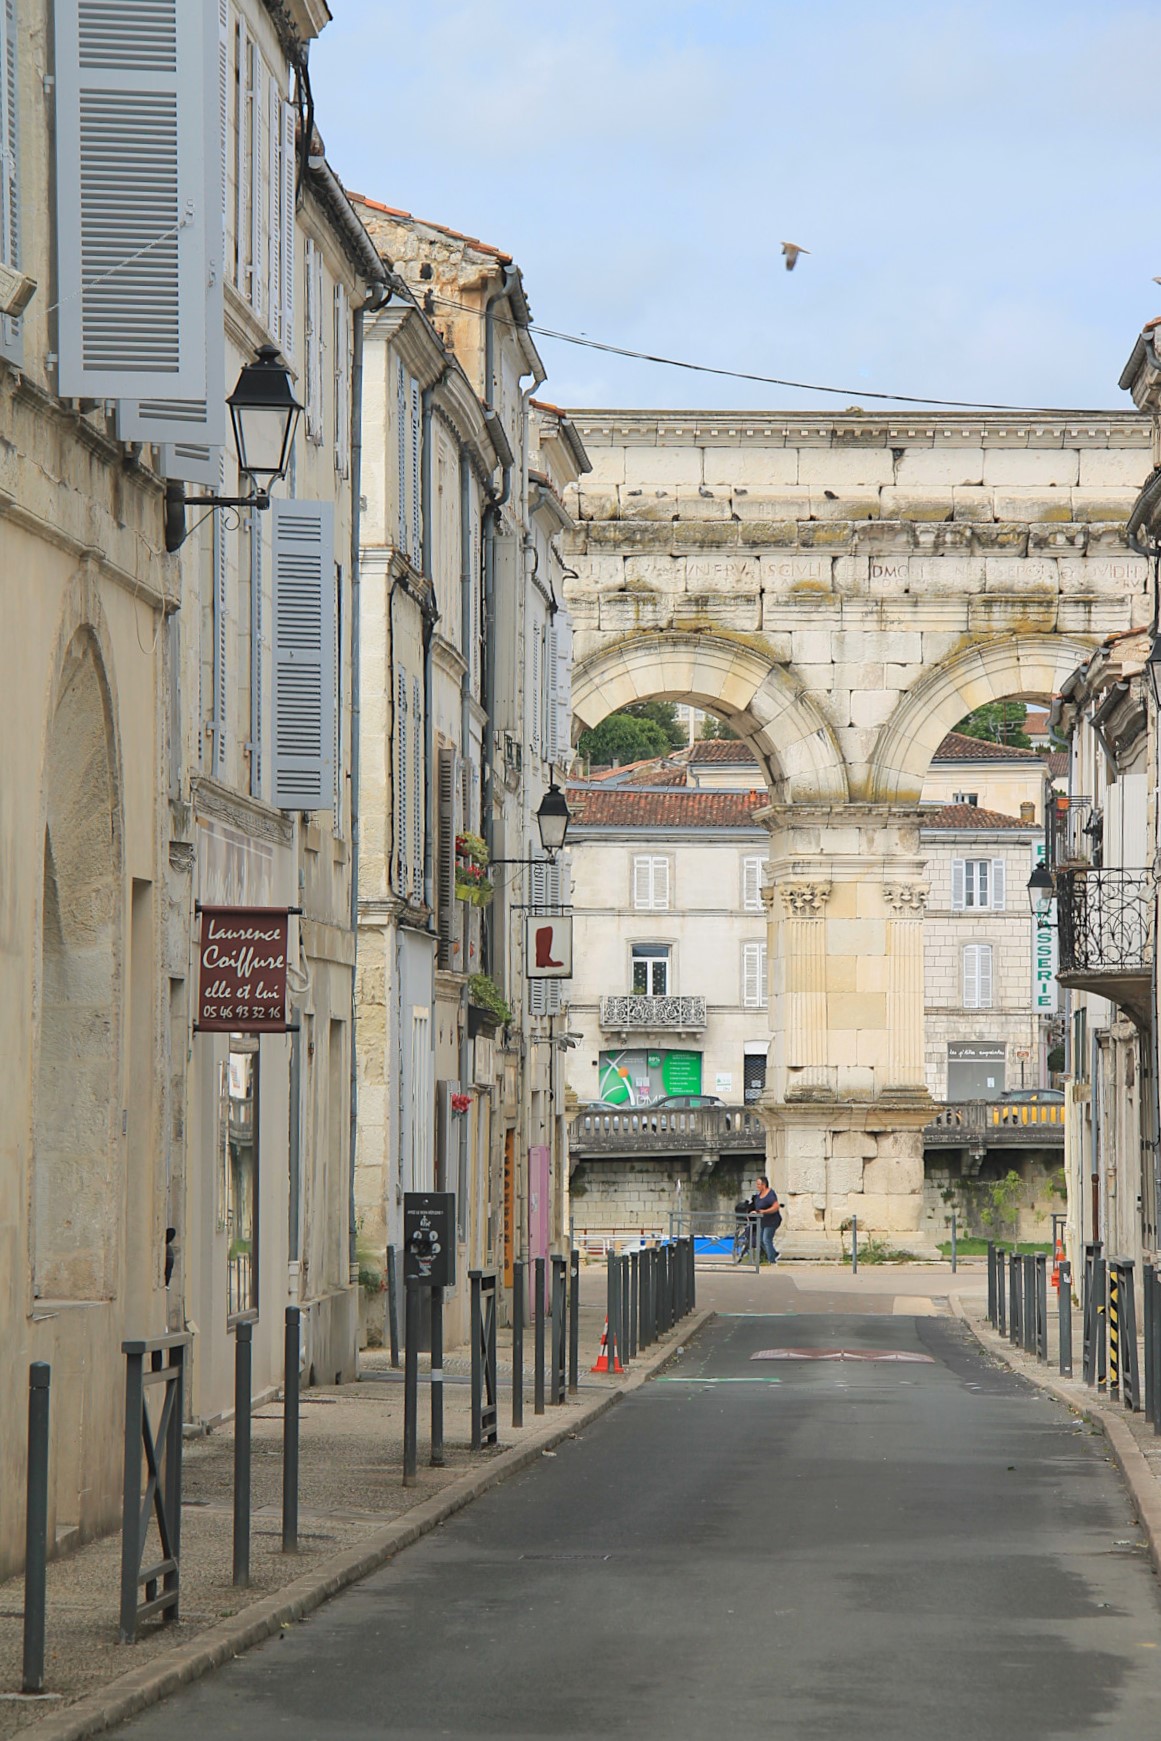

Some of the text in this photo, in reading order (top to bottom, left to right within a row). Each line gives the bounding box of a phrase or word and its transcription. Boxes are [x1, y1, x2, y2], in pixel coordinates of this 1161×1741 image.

[208, 919, 281, 941] Laurence
[202, 945, 285, 978] Coiffure
[204, 980, 280, 999] elle et lui
[203, 1005, 281, 1018] 05 46 93 32 16
